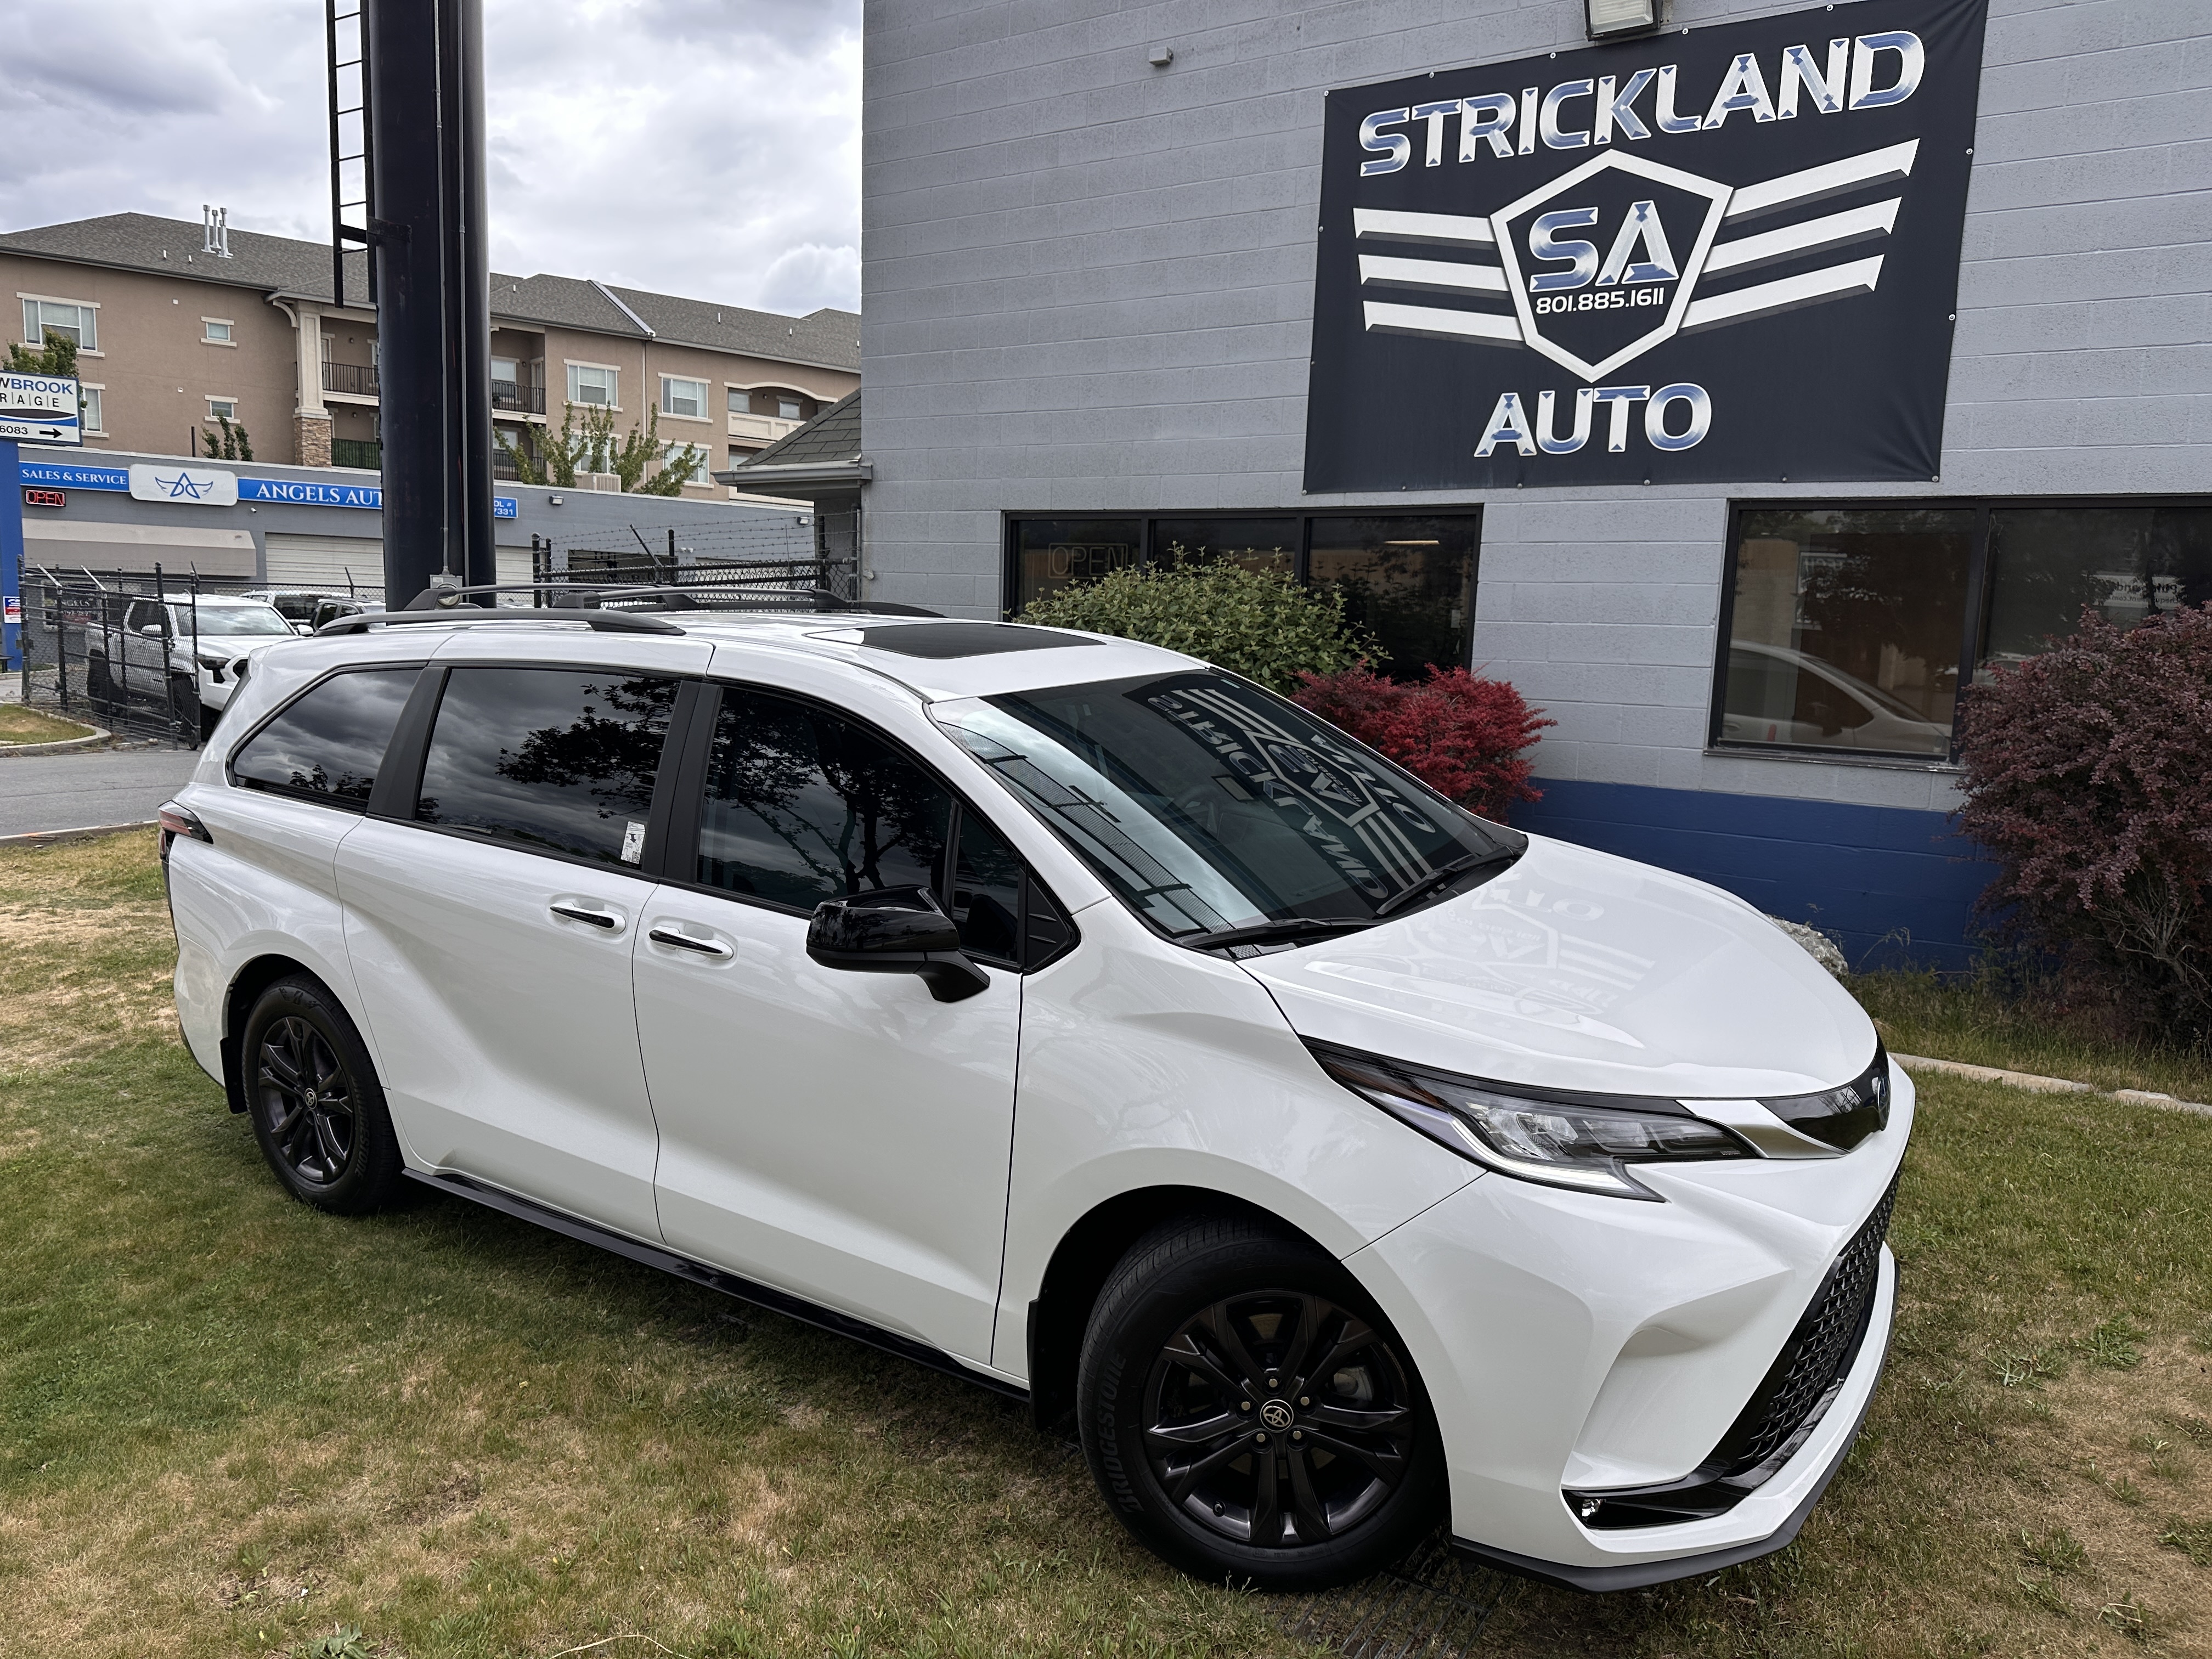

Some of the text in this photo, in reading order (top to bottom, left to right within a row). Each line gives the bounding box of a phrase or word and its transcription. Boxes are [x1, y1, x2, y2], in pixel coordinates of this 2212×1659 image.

[1358, 30, 1925, 177] STRICKLAND
[1528, 200, 1679, 292] SA
[1535, 286, 1665, 315] 801.885.1611
[0, 425, 28, 435] 6083
[1473, 382, 1713, 458] AUTO
[22, 469, 127, 484] SALES & SERVICE
[27, 491, 64, 506] OPEN
[256, 482, 340, 503] ANGELS
[1052, 546, 1124, 576] OPEN
[1098, 1353, 1144, 1513] BRIDGESTONE
